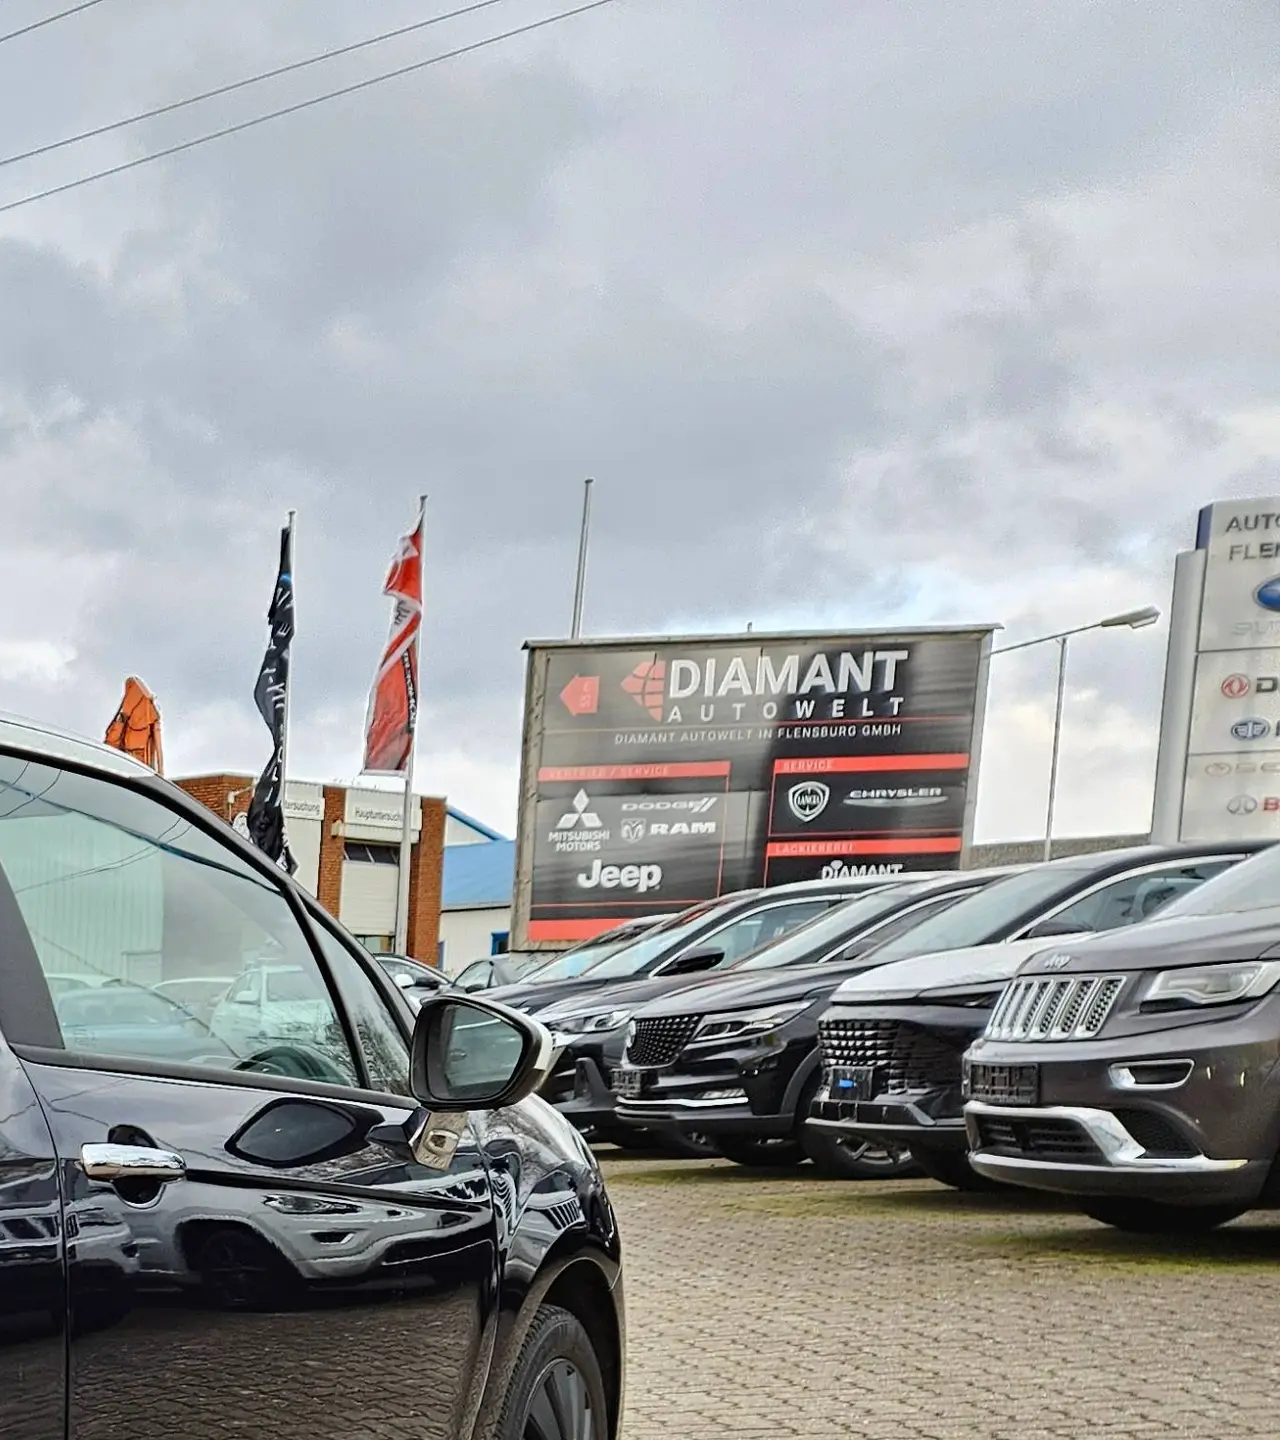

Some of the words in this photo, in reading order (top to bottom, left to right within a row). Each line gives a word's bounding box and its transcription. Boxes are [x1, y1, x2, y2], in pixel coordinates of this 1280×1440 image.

[1225, 513, 1280, 532] AUT
[1229, 543, 1280, 560] FLE
[669, 651, 909, 699] DIAMANT
[667, 697, 904, 723] AUTOWELT
[615, 733, 675, 745] DIAMANT
[680, 729, 753, 743] AUTOWELT
[758, 729, 773, 740] IN
[778, 725, 857, 740] FLENSBURG
[862, 724, 902, 737] GMBH
[783, 759, 833, 770] SERVICE
[850, 787, 942, 798] CHRYSLER
[548, 829, 611, 842] MITSUBISHI
[649, 821, 717, 836] RAM
[556, 841, 601, 851] MOTORS
[577, 859, 663, 893] Jeep
[822, 860, 903, 880] DIAMANT
